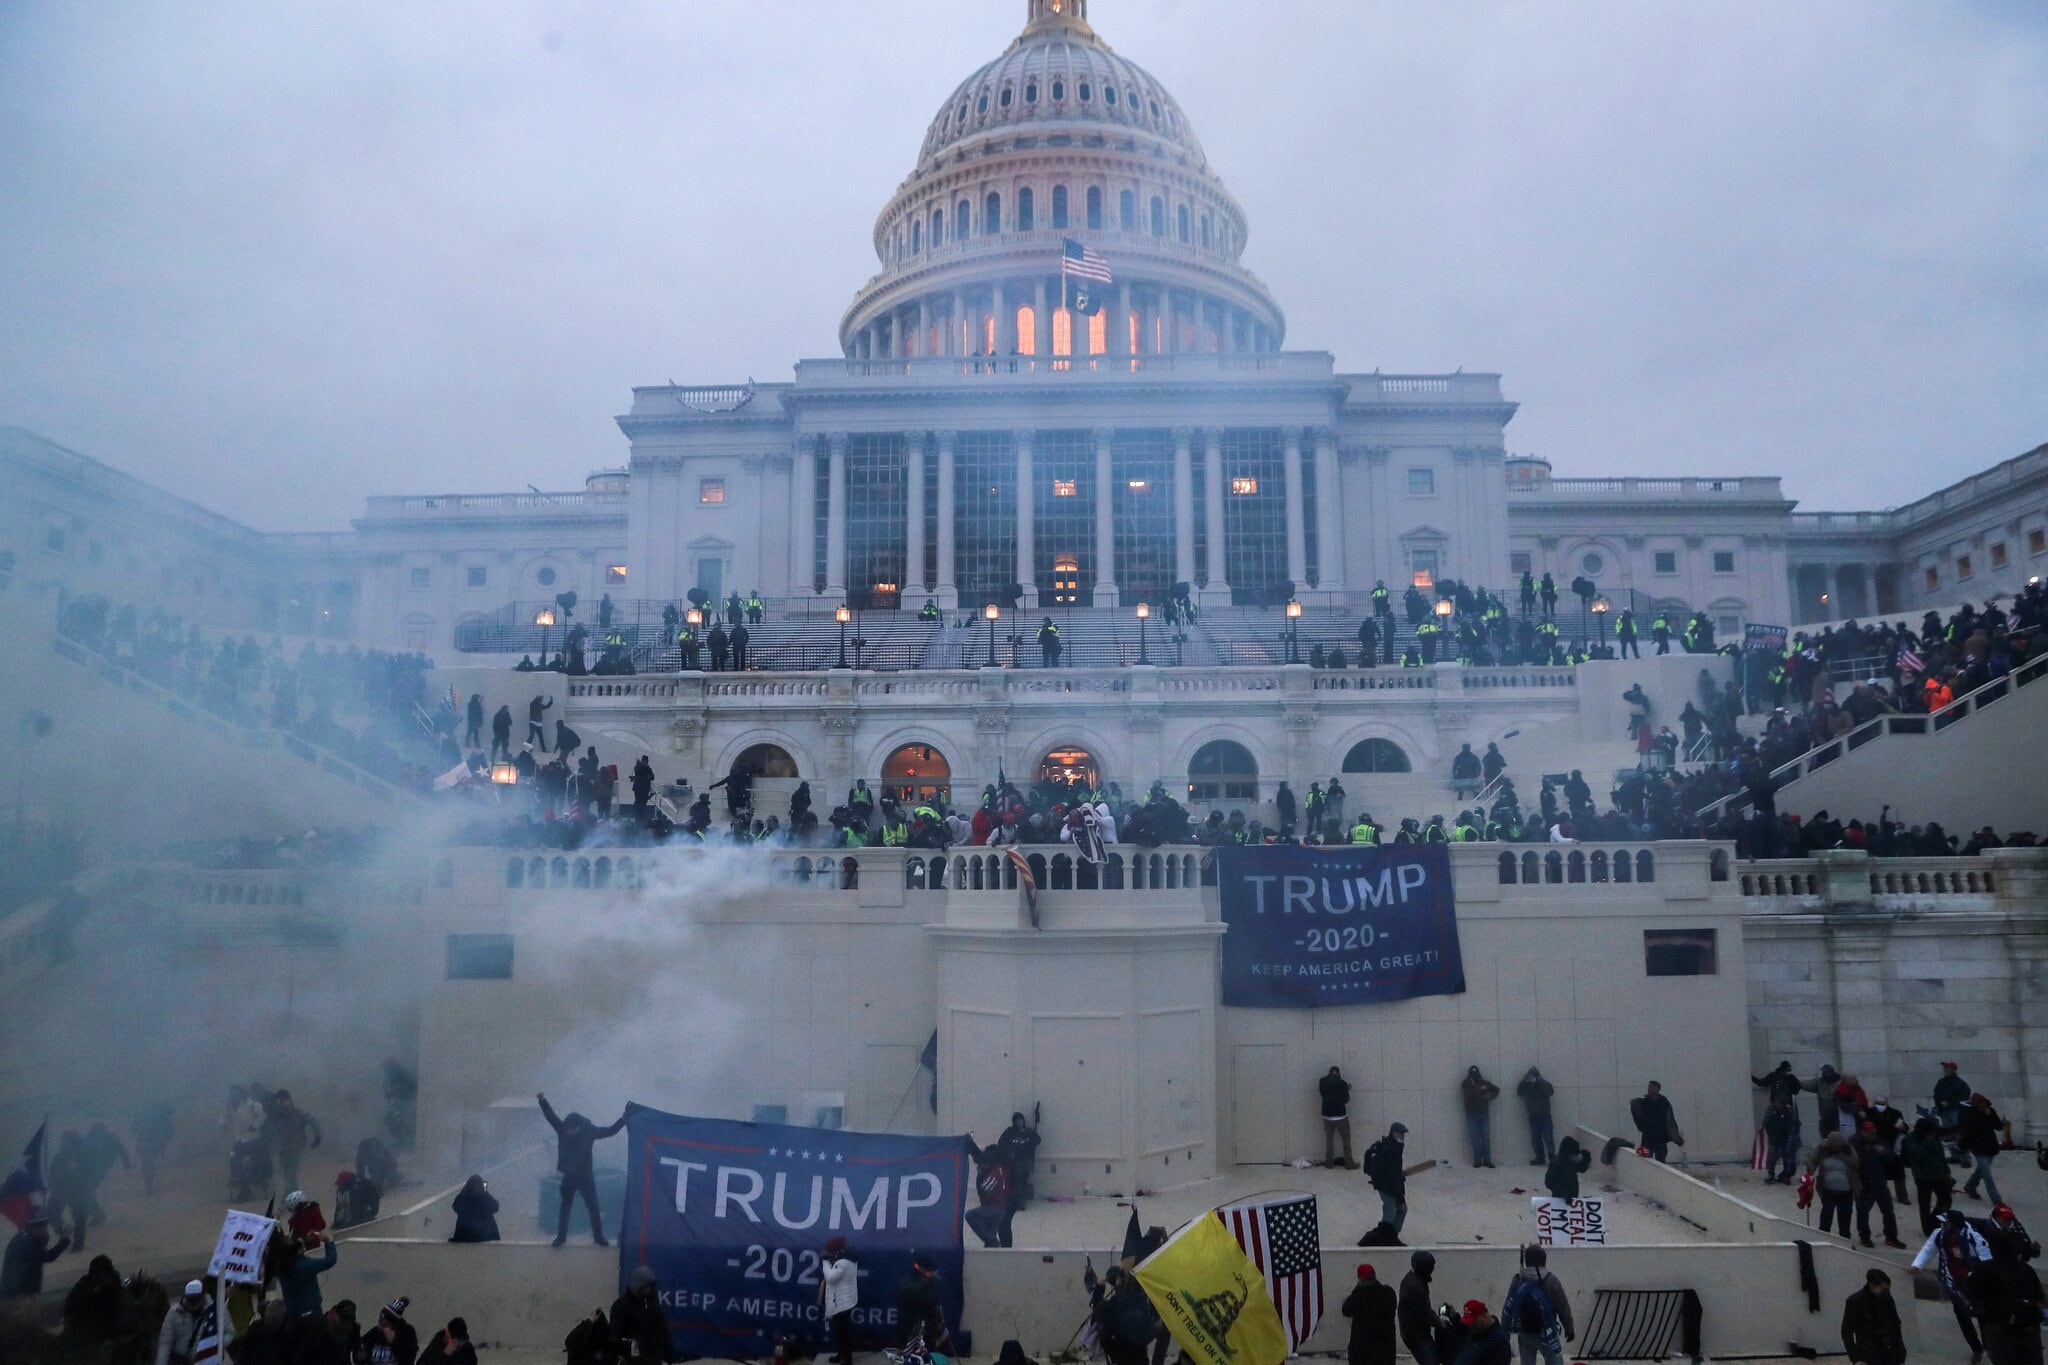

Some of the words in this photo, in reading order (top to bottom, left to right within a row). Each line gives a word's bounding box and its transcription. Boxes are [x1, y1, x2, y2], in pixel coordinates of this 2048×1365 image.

[1244, 863, 1426, 914] TRUMP
[1295, 924, 1389, 952] -2020-
[1252, 963, 1293, 977] KEEP
[1299, 959, 1374, 977] AMERICA
[1380, 950, 1440, 970] GREAT!
[659, 1156, 943, 1231] TRUMP
[1537, 1203, 1552, 1245] VOTE
[1552, 1209, 1571, 1234] MY
[1570, 1199, 1586, 1244] STEAL
[225, 1262, 249, 1273] STEAL
[657, 1290, 717, 1312] KEEP
[726, 1297, 820, 1322] AMERIC
[1182, 1314, 1205, 1344] TREAD
[1204, 1343, 1218, 1359] ON
